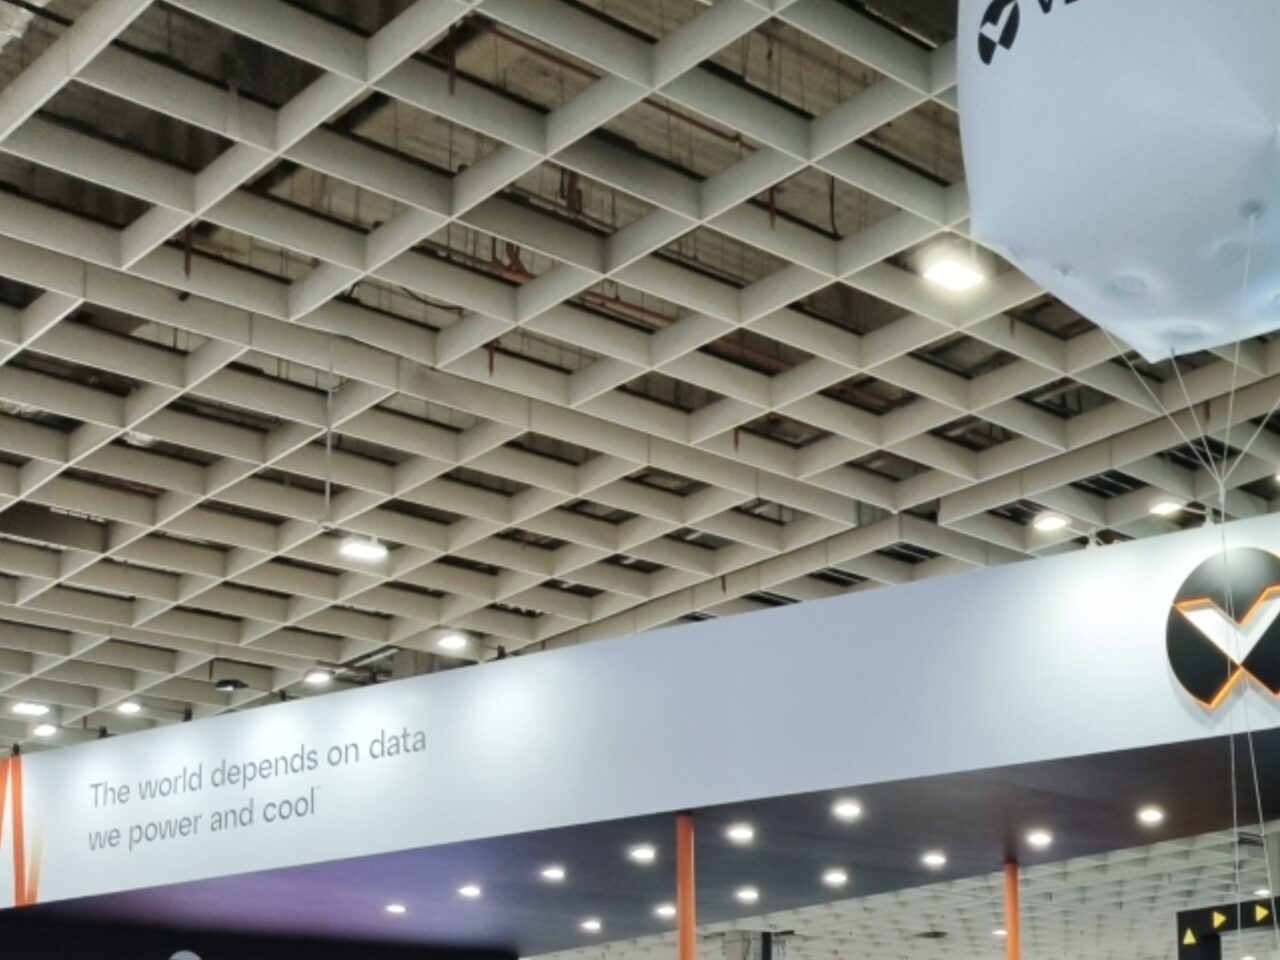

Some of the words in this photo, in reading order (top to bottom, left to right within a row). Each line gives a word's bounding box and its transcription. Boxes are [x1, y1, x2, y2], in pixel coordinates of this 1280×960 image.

[90, 780, 130, 808] The
[138, 762, 202, 801] world
[211, 743, 318, 790] depends
[327, 742, 360, 767] on
[369, 726, 427, 759] data
[88, 827, 121, 851] we
[128, 813, 202, 852] power
[210, 797, 254, 832] and
